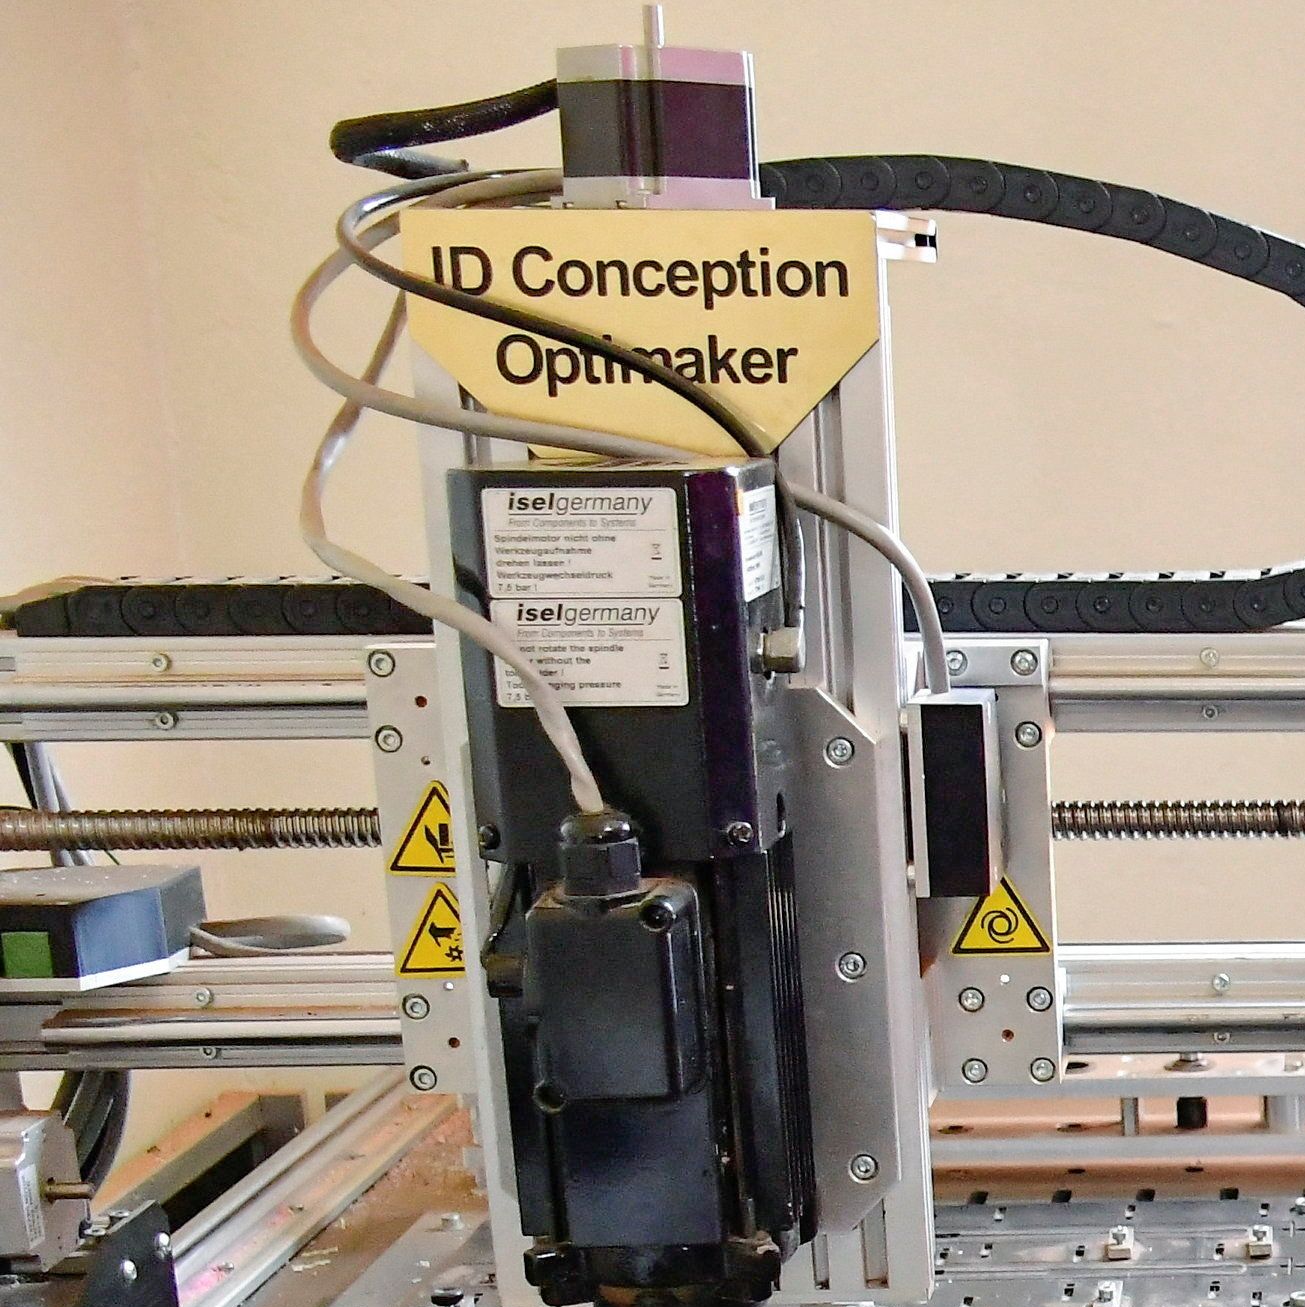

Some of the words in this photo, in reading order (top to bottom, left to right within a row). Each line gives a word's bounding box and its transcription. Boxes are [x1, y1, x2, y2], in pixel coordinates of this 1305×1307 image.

[431, 246, 493, 296] ID
[512, 246, 849, 310] Conception
[496, 333, 799, 398] Optimaker
[508, 492, 653, 515] iselgermany
[564, 534, 589, 543] nicht
[517, 603, 660, 626] iselgermany
[589, 644, 624, 653] spindle
[579, 681, 622, 690] pressure
